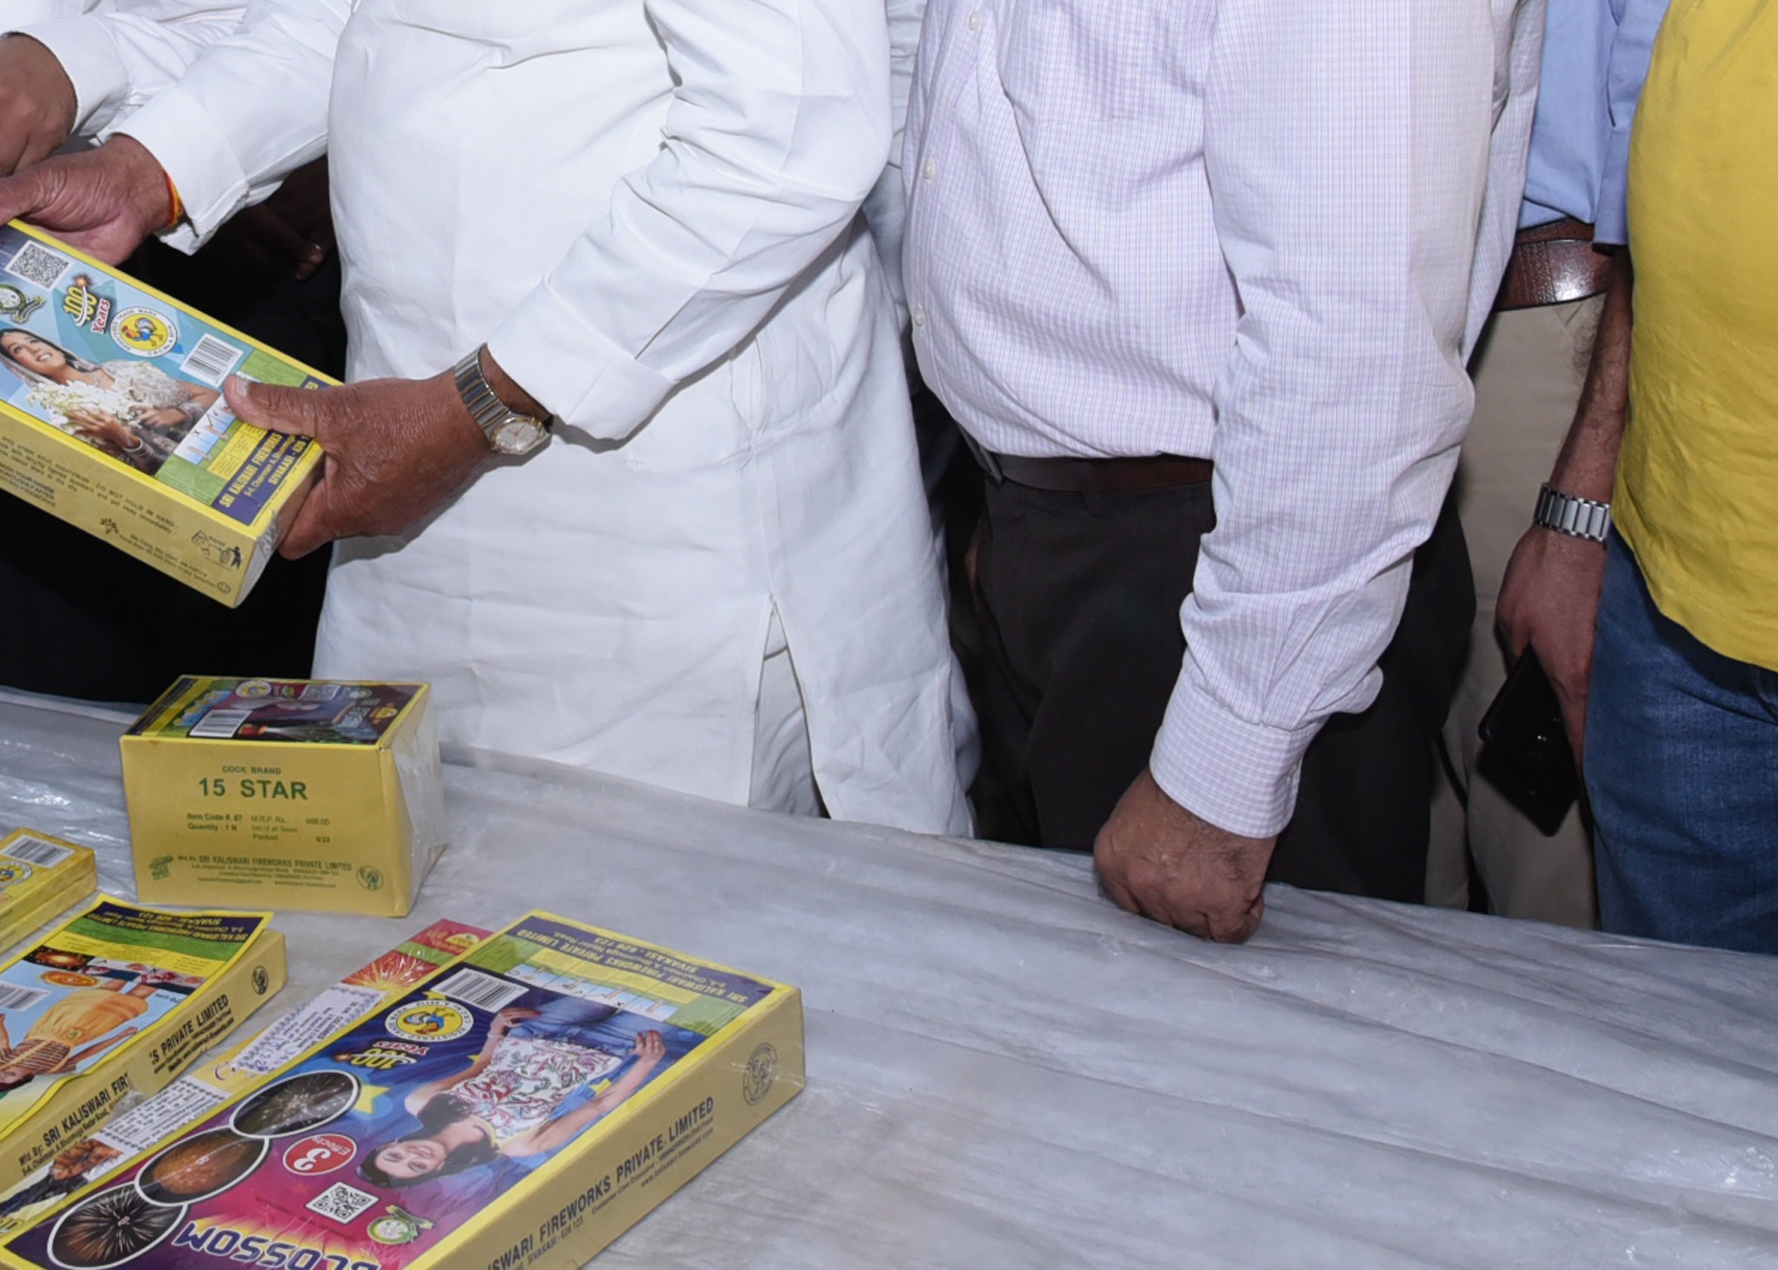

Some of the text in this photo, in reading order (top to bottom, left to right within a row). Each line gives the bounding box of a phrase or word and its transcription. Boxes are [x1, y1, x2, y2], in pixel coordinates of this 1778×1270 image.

[59, 284, 99, 322] 100
[90, 297, 112, 335] Years
[221, 765, 281, 775] COCK BRAND
[197, 777, 308, 800] 15 STAR
[187, 822, 218, 831] Quantity
[212, 856, 249, 864] KALISWARI
[252, 858, 291, 866] FIREWORKS
[294, 860, 322, 868] PRIVATE
[324, 862, 351, 870] LIMITED
[515, 925, 748, 1005] SRI KALISWARI FIREWORKS PRIVATE LIMITED
[644, 947, 699, 975] SIVAKASI
[40, 1126, 62, 1147] SRI
[58, 1087, 113, 1133] KALISWARI
[157, 1019, 198, 1055] PRIVATE
[192, 993, 231, 1027] LIMITED
[350, 1039, 405, 1077] 100
[292, 1145, 331, 1172] 3
[312, 1135, 353, 1160] Effects
[489, 1235, 533, 1270] SWARI
[540, 1175, 611, 1243] FIREWORKS
[611, 1134, 668, 1183] PRIVATE
[664, 1095, 719, 1142] LIMITED
[528, 1237, 558, 1265] SIVAKASI
